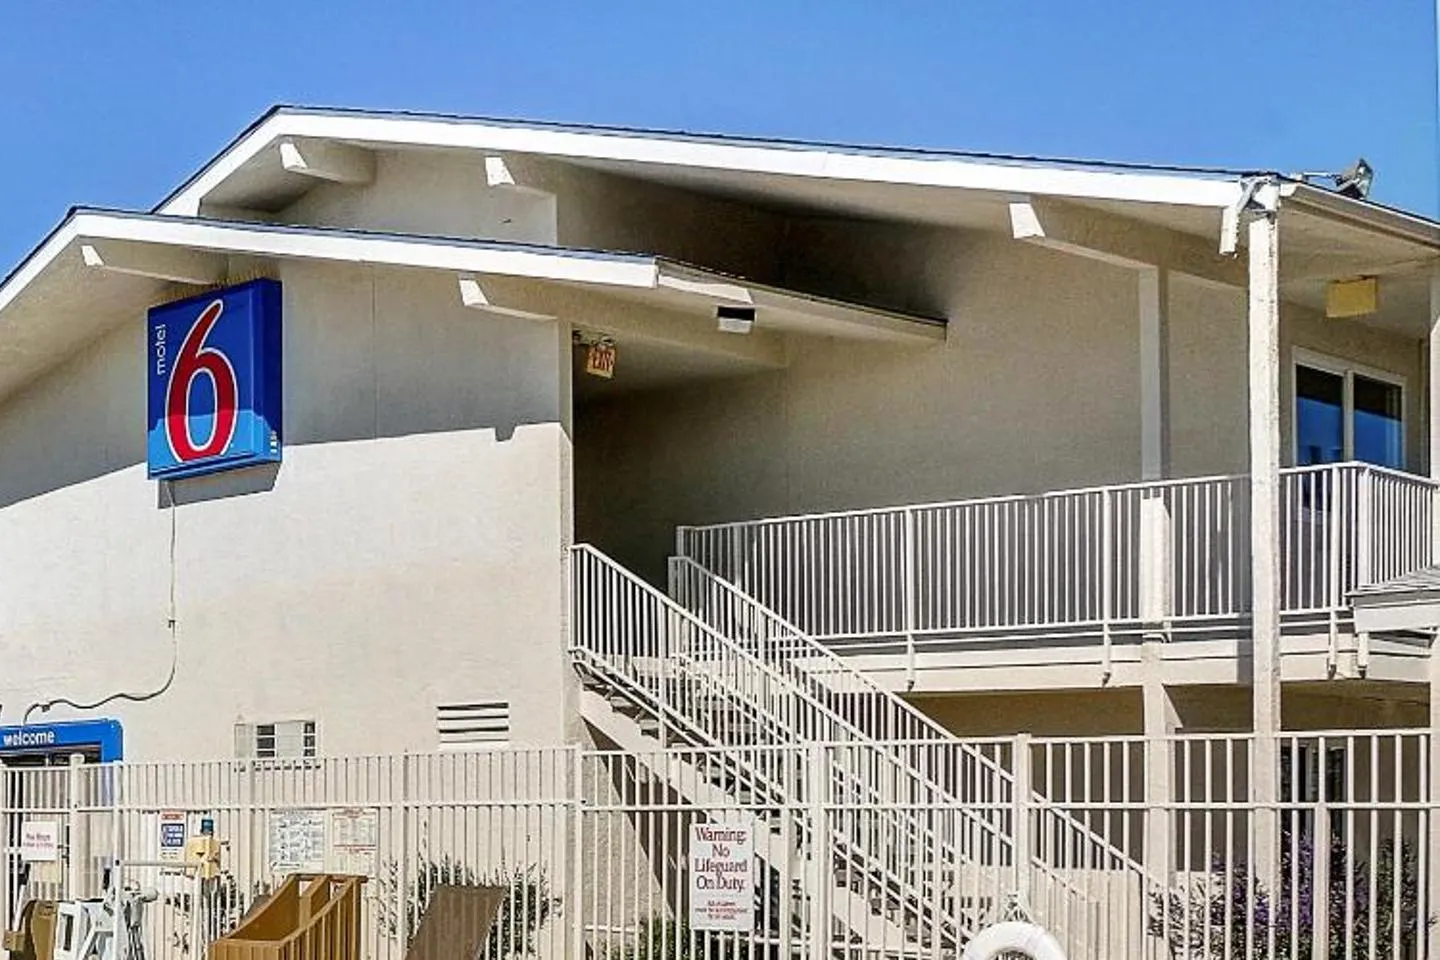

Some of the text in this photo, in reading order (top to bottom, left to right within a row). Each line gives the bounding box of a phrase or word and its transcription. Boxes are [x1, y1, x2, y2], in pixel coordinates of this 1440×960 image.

[154, 299, 240, 464] motel 6
[3, 731, 55, 746] welcome
[712, 843, 730, 858] No
[694, 858, 748, 878] Lifeguard
[696, 875, 715, 890] On
